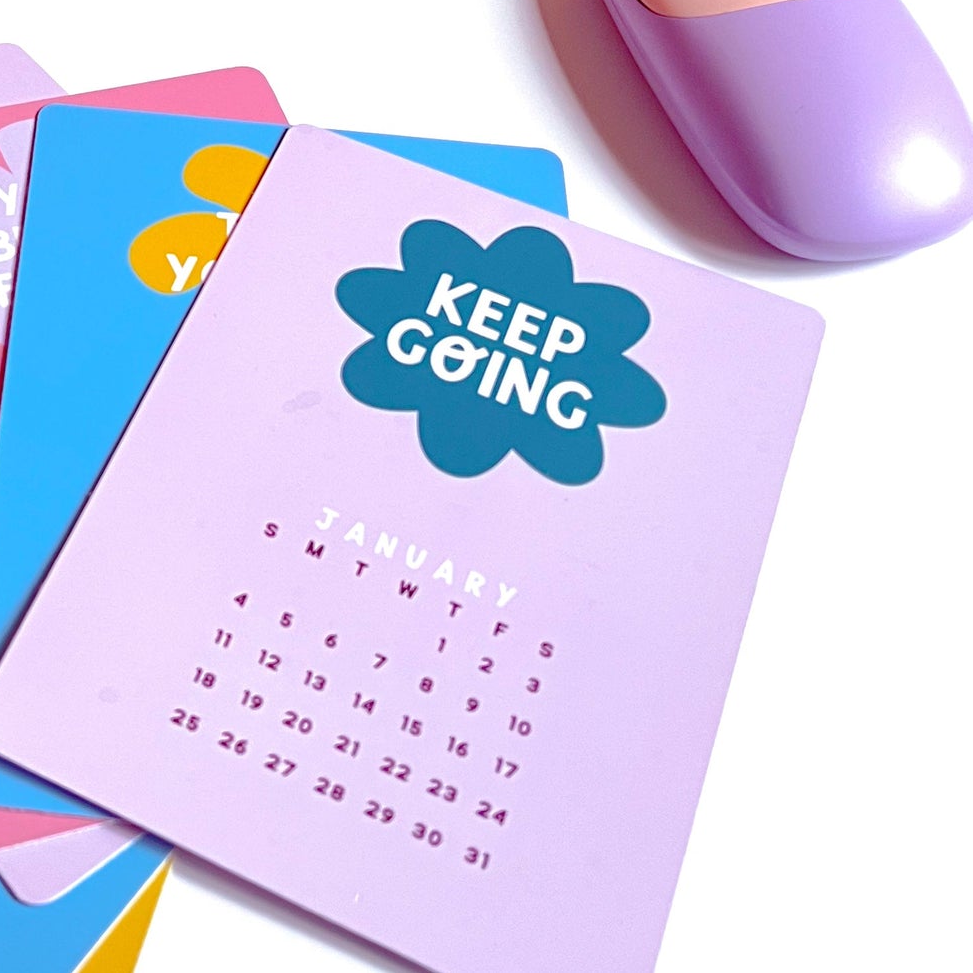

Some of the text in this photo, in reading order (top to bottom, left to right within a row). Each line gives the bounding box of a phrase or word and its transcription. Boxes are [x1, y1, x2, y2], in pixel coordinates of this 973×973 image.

[386, 317, 593, 430] GOING
[426, 272, 586, 363] KEEP
[263, 521, 554, 659] S M T W T F S
[314, 506, 518, 608] JANUARY
[214, 628, 520, 779] 11 12 13 14 15 16 17
[233, 592, 532, 737] 4 5 6 7 8 9 10
[436, 636, 541, 694] 1 2 3
[169, 707, 491, 870] 25 26 27 28 29 30 31
[192, 666, 508, 826] 18 19 20 21 22 23 24
